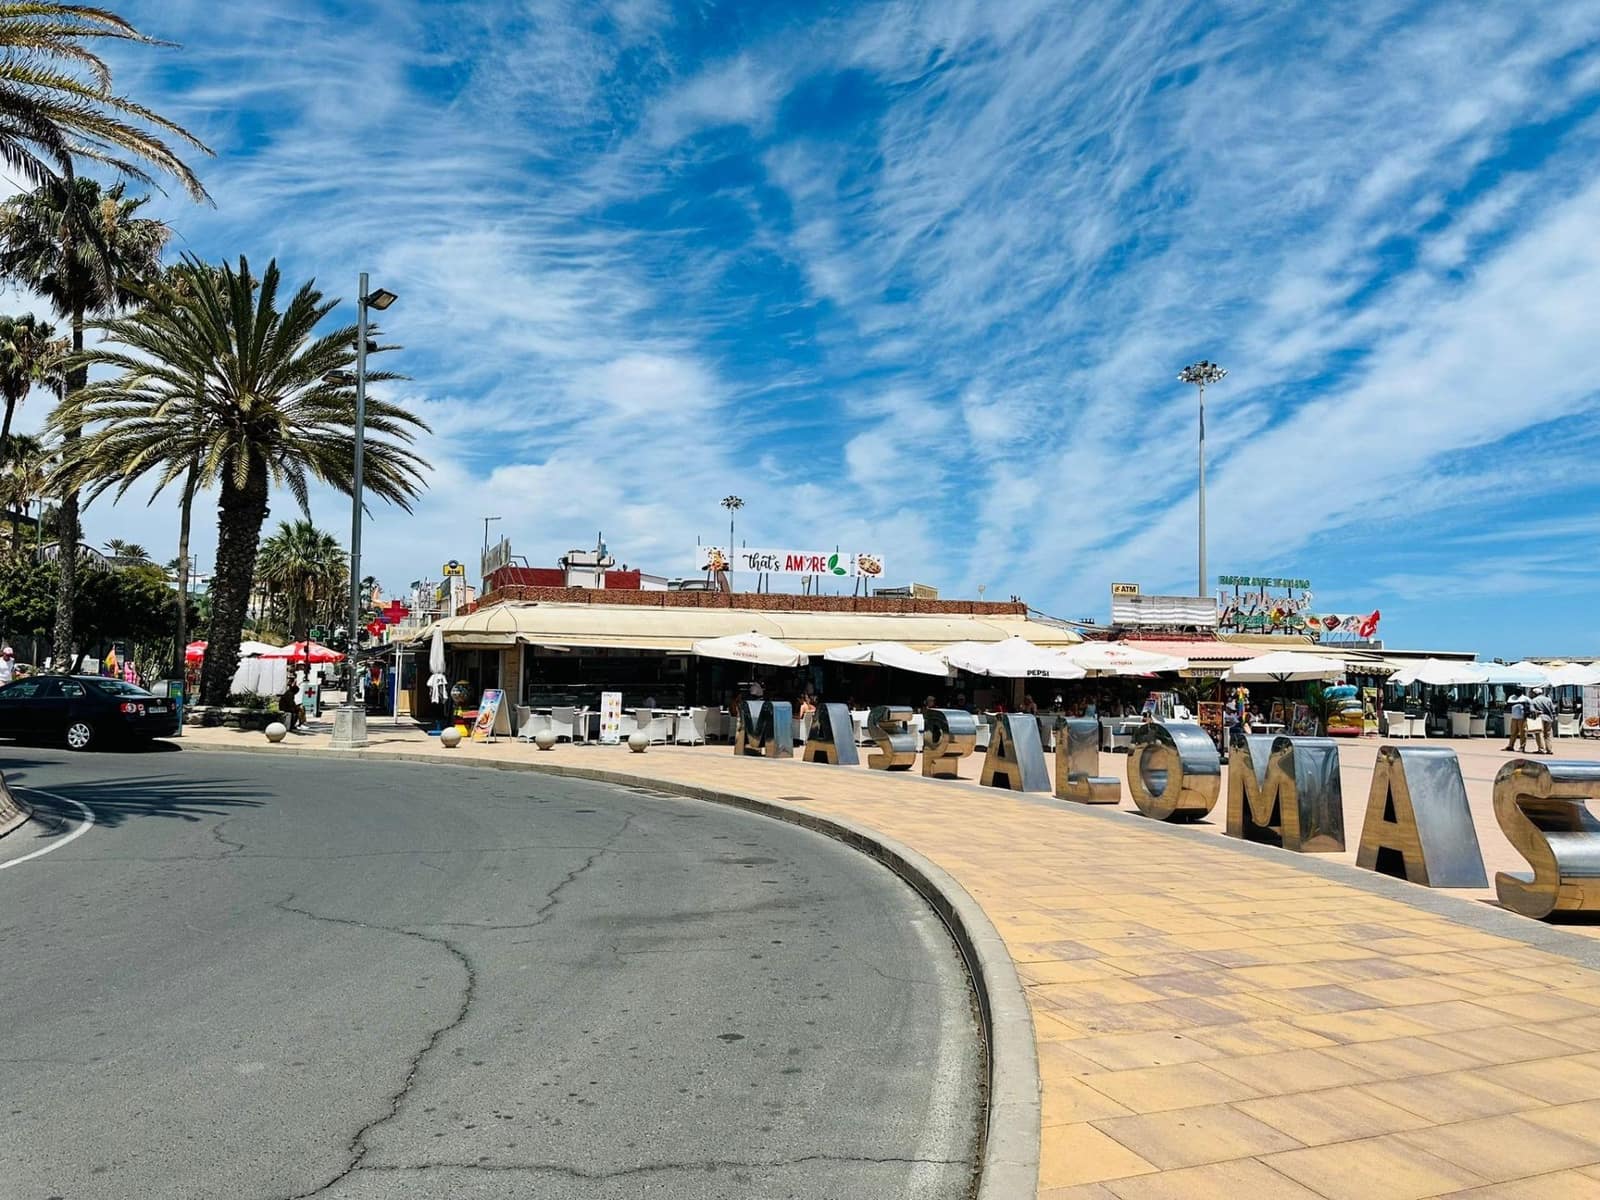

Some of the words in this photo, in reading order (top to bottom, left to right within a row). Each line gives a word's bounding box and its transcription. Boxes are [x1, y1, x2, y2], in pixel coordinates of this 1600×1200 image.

[742, 551, 780, 572] that's
[1120, 585, 1137, 594] ATM
[1026, 669, 1050, 677] PEPSI
[734, 700, 1600, 919] MASPALOMAS
